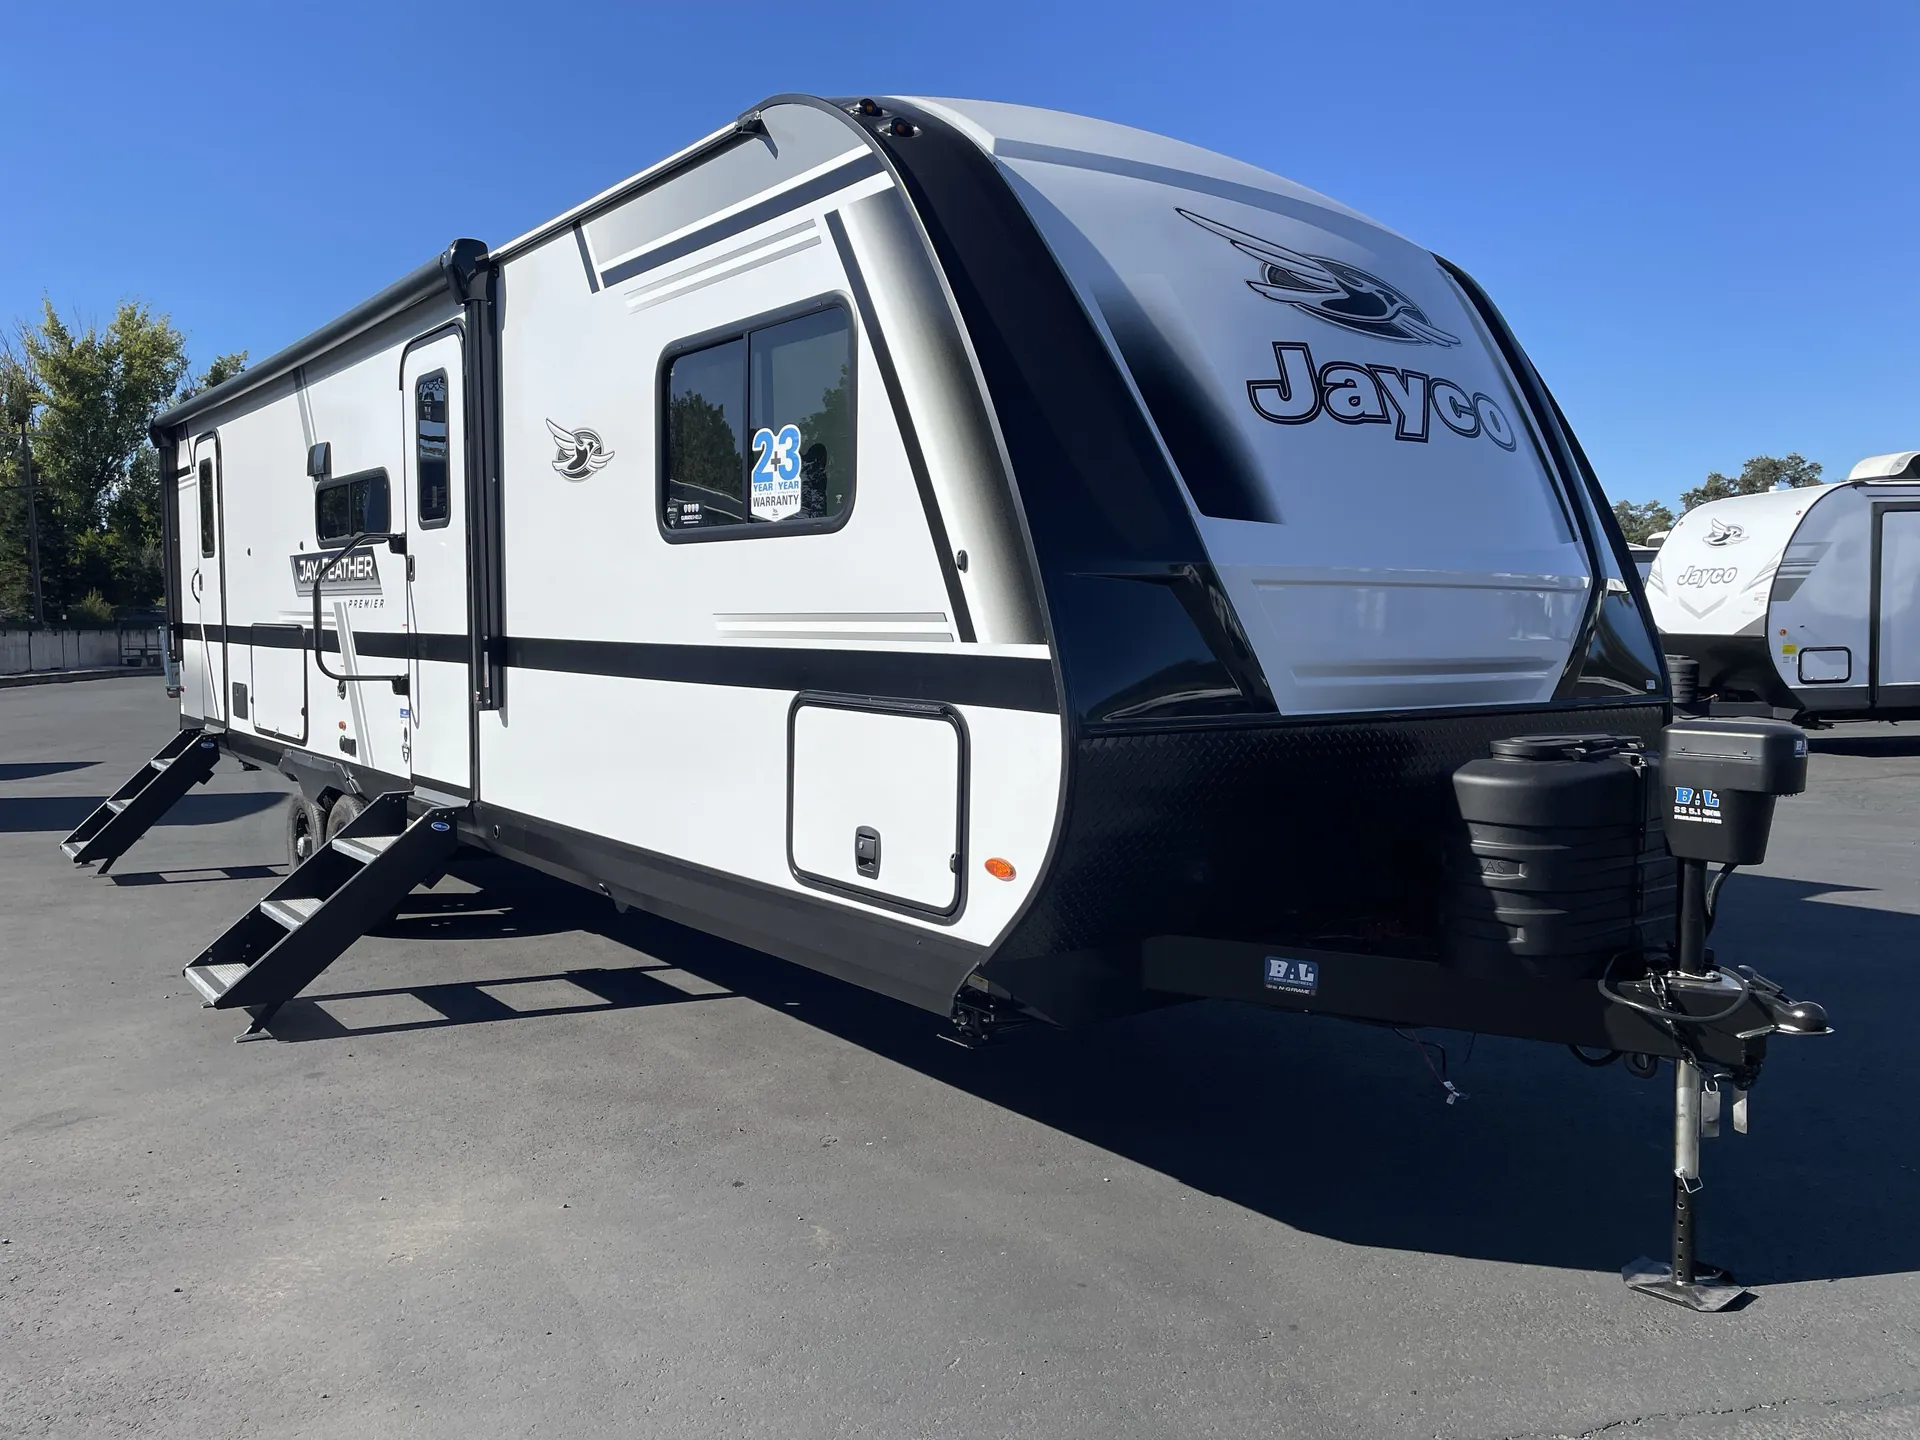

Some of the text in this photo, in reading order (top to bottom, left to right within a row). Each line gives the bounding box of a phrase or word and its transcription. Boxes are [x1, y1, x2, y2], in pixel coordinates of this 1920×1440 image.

[1246, 341, 1517, 452] Jayco
[753, 481, 799, 492] YEAR YEAR
[753, 494, 799, 507] WARRANTY
[299, 560, 318, 581] JAY
[1677, 565, 1737, 588] Jayco
[348, 599, 385, 609] PREMIER
[1675, 787, 1720, 807] BAL
[1269, 959, 1315, 982] BAL
